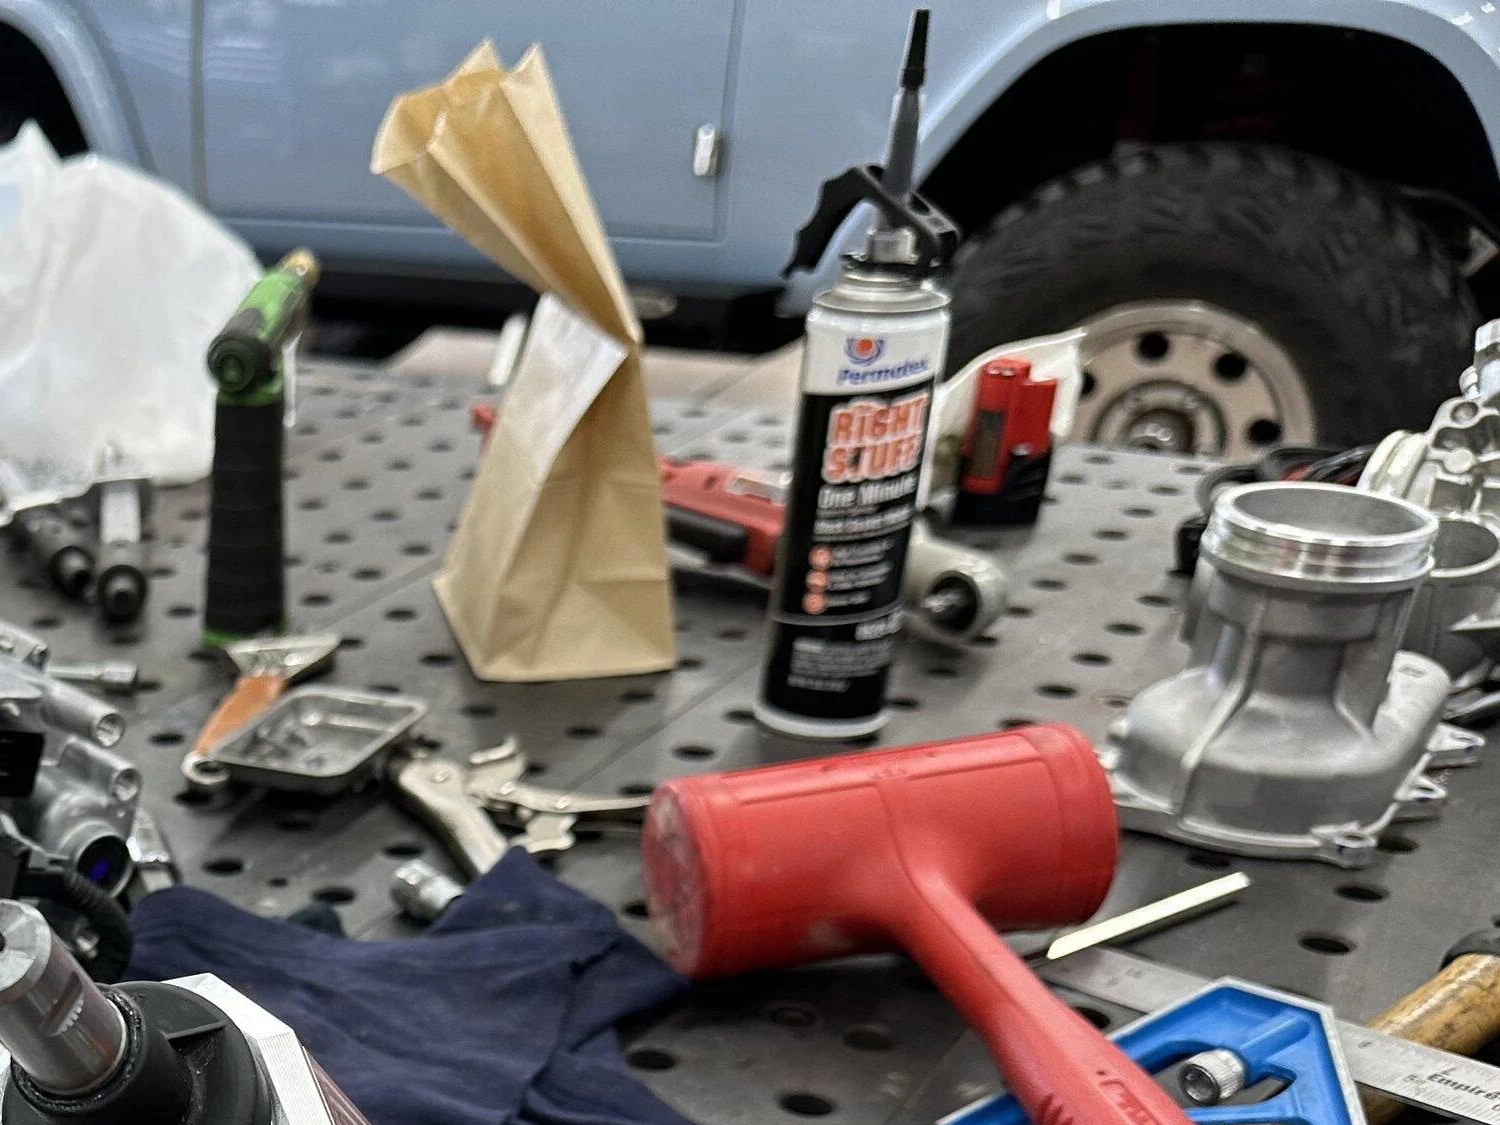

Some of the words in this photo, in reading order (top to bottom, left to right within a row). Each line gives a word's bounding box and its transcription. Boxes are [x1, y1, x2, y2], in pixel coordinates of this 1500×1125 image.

[837, 358, 929, 385] Permatex
[832, 393, 929, 444] RIGHT
[826, 434, 919, 478] STUFF
[1426, 1072, 1500, 1101] Empire
